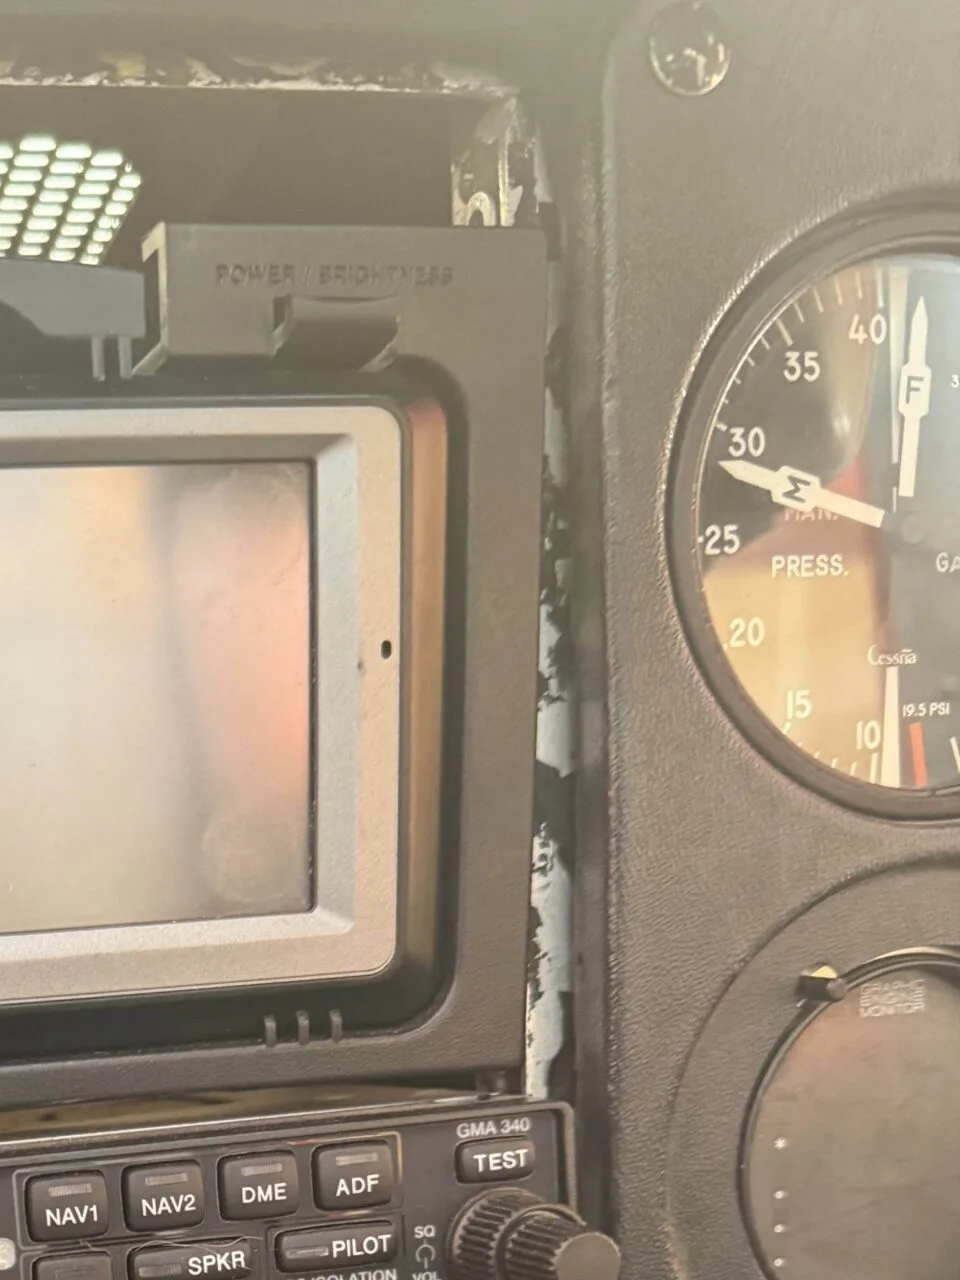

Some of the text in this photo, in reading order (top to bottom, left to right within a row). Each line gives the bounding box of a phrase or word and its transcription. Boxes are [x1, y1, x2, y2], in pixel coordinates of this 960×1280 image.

[215, 263, 294, 286] POWER
[848, 313, 887, 345] 40
[783, 351, 820, 382] 35
[906, 376, 925, 404] F
[728, 426, 765, 457] 30
[704, 525, 740, 555] 25
[771, 554, 850, 578] PRESS.
[729, 617, 765, 648] 20
[786, 689, 812, 720] 15
[902, 702, 951, 717] 19.5 PSI
[856, 720, 882, 750] 10
[457, 1117, 531, 1139] GMA 340
[473, 1149, 528, 1173] TEST
[241, 1182, 288, 1204] DME
[336, 1174, 380, 1197] ADF
[45, 1204, 99, 1227] NAV1
[141, 1194, 197, 1217] NAV2
[414, 1224, 436, 1239] SQ
[331, 1234, 392, 1259] PILOT
[187, 1250, 246, 1276] SPKR
